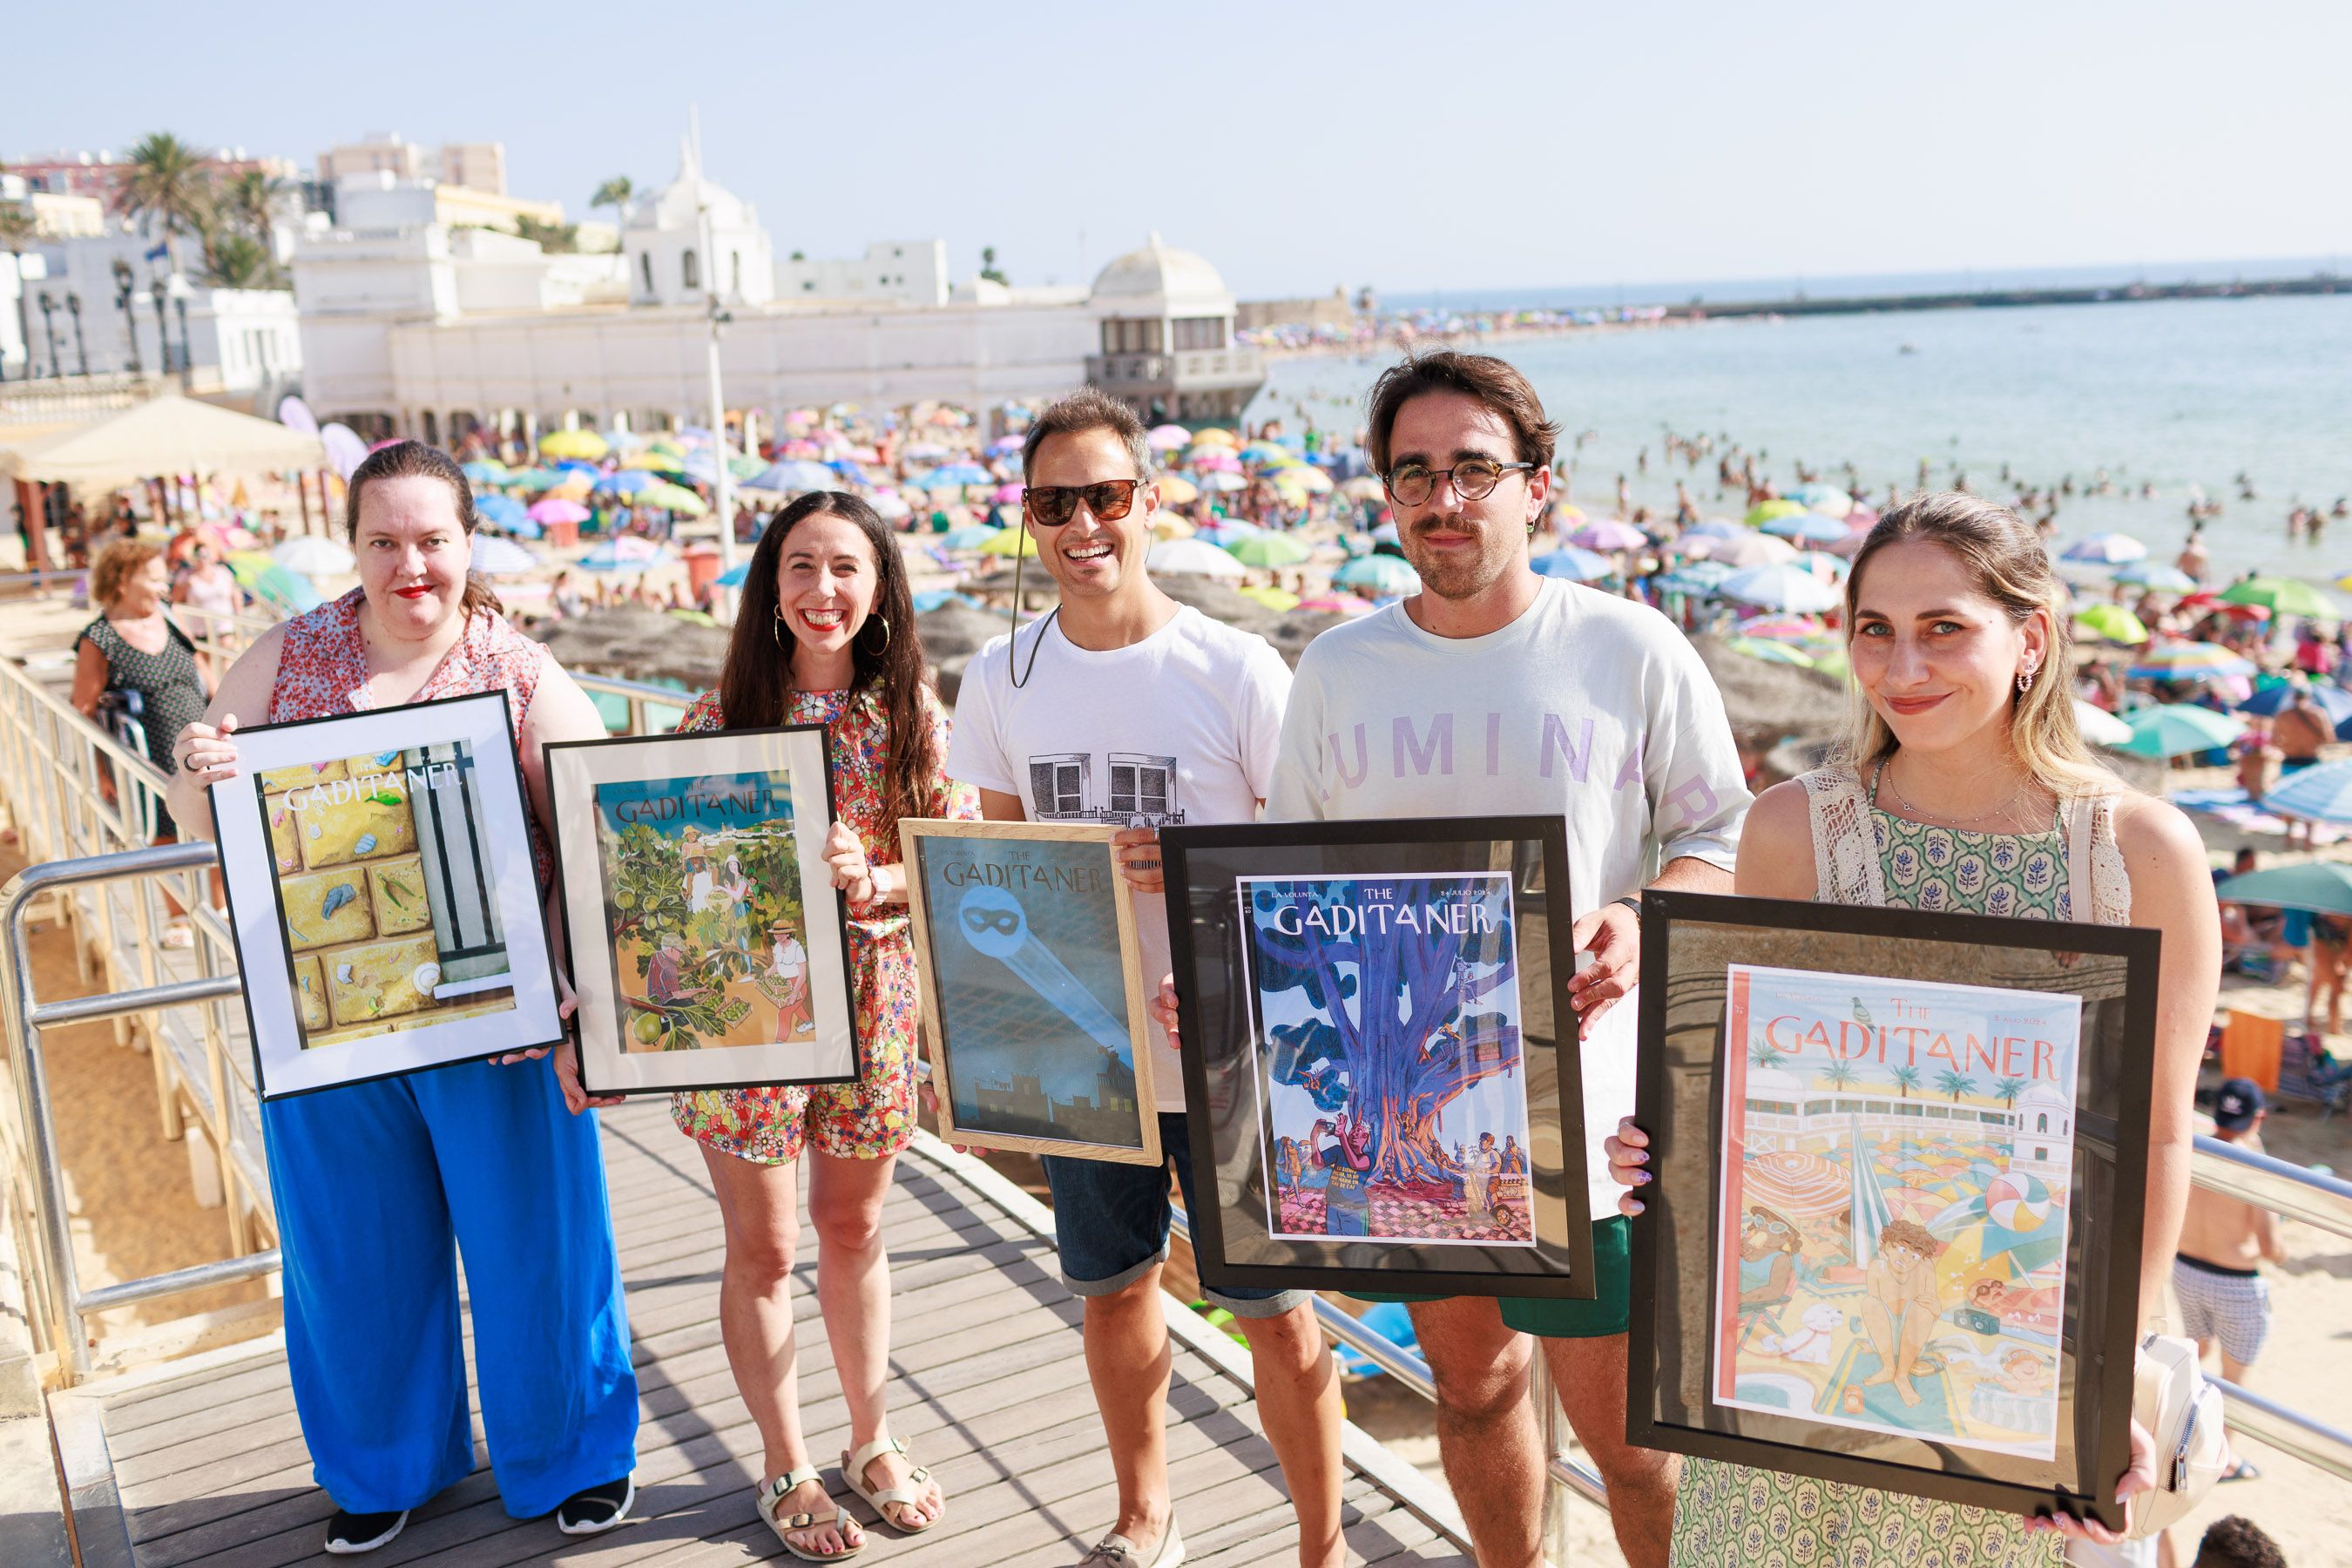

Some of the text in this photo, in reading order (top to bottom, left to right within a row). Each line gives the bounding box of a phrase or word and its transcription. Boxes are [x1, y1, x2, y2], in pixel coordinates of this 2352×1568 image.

[282, 762, 463, 812] GADITANER
[1318, 713, 1727, 836] UMINAR
[615, 789, 780, 823] GADITANER
[1008, 850, 1031, 862] THE
[943, 862, 1107, 894] GADITANER
[1364, 888, 1393, 900] THE
[1274, 903, 1494, 936] GADITANER
[1890, 997, 1931, 1021] THE
[1765, 1016, 2060, 1081] GADITANER
